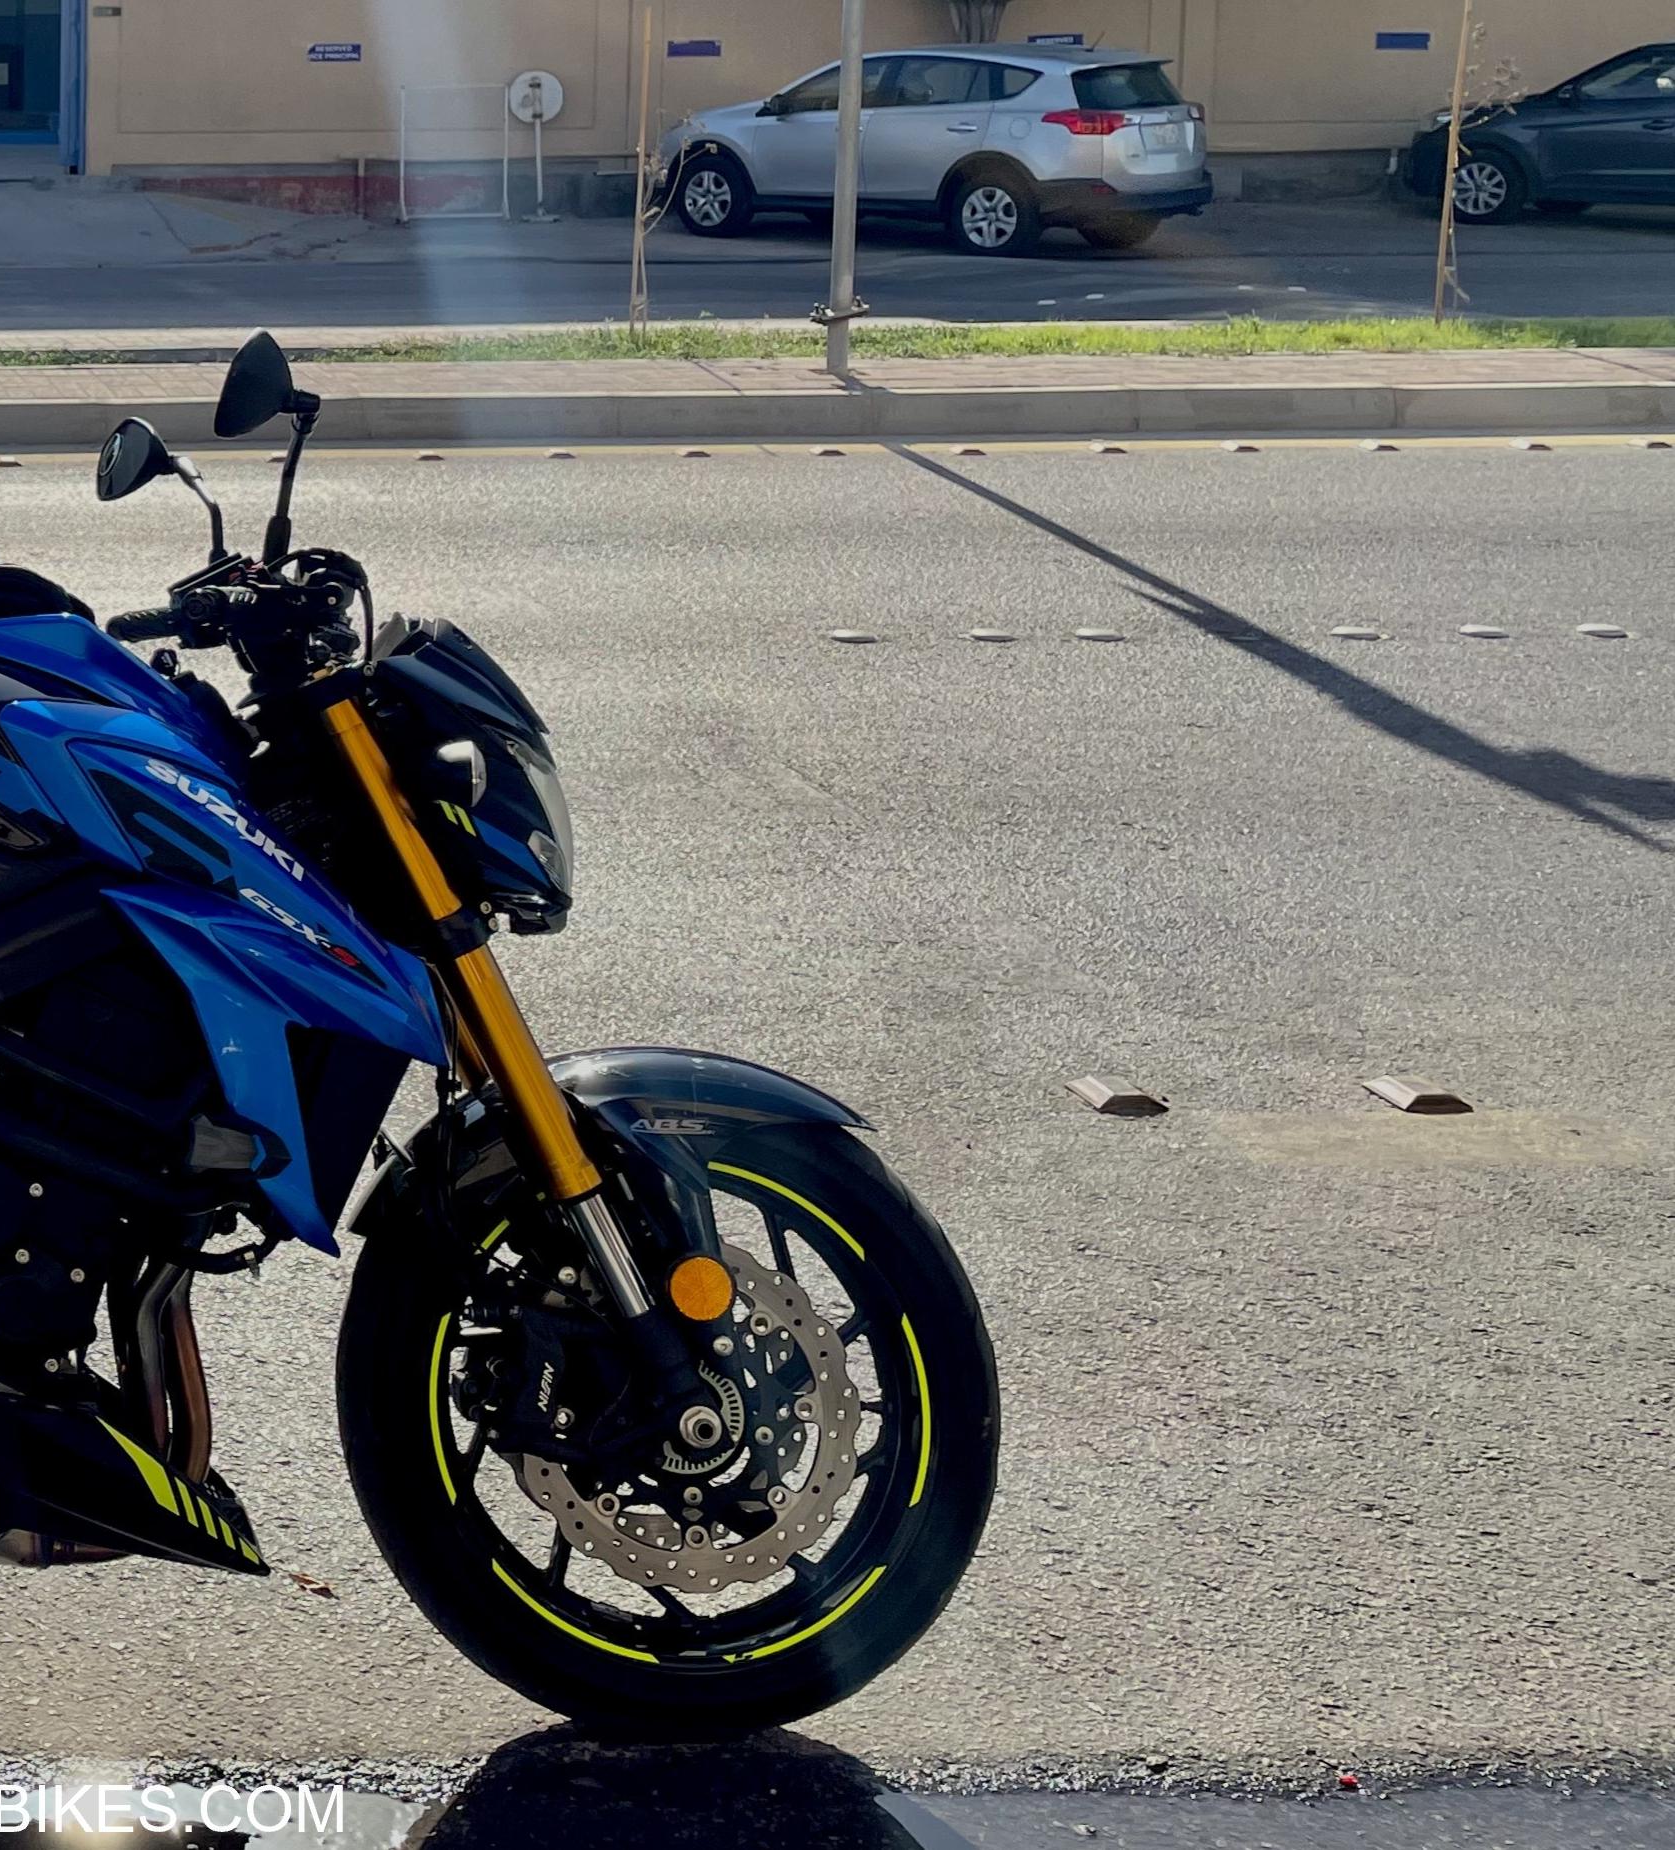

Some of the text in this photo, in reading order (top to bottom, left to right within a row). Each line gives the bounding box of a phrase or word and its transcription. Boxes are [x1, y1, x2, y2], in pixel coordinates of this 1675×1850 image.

[145, 758, 305, 882] SUZUKI
[239, 888, 361, 967] GSX-S
[630, 1118, 709, 1131] ABS
